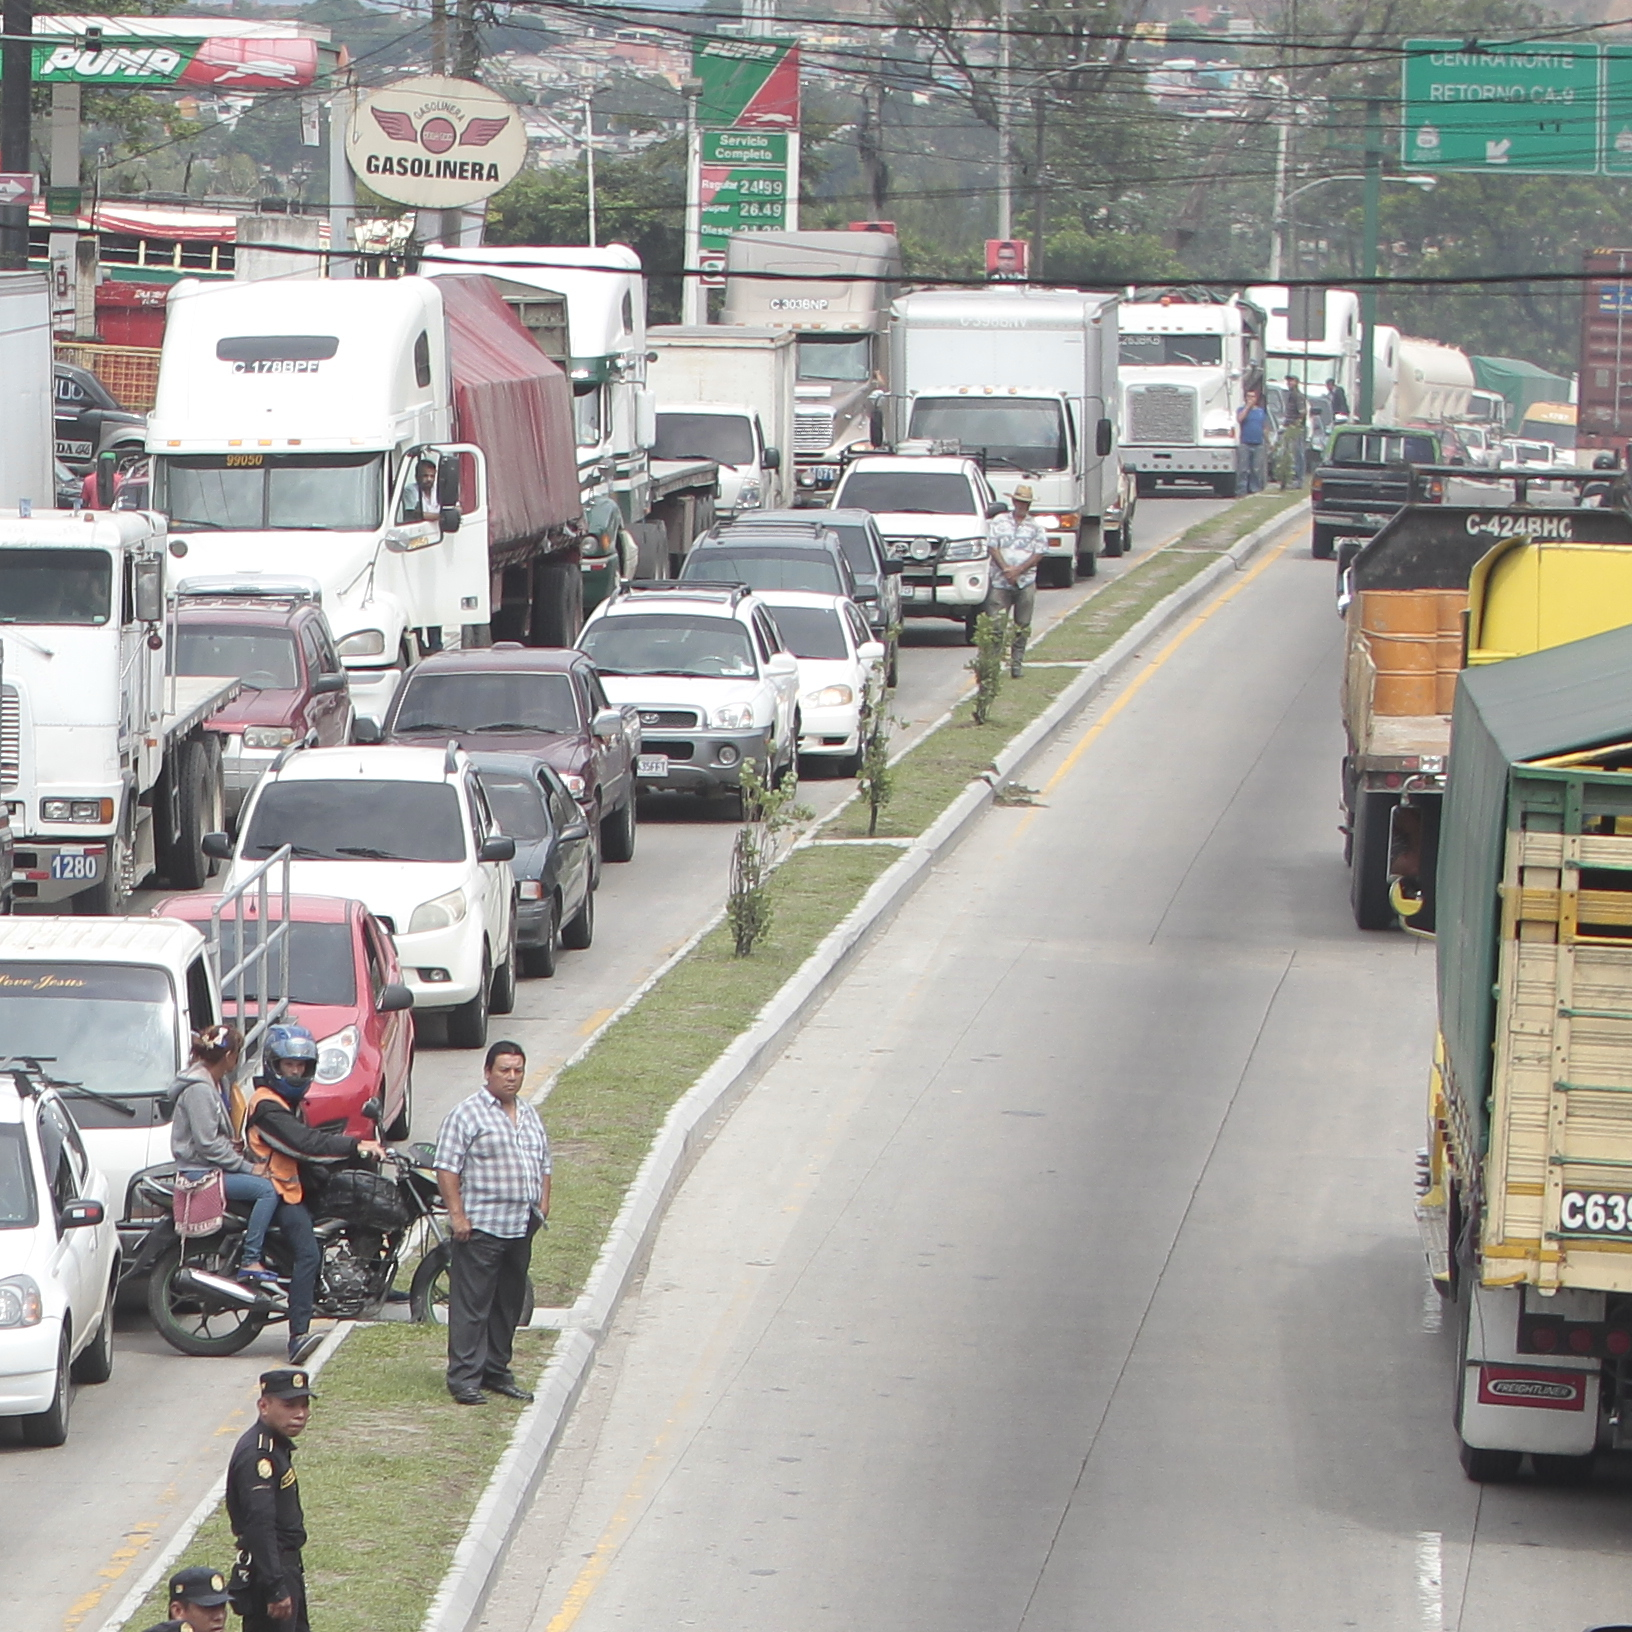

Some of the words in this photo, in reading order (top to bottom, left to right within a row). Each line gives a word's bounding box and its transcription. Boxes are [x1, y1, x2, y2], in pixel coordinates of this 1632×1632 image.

[40, 46, 182, 76] PUMA
[1510, 52, 1575, 70] NORTE
[1430, 84, 1526, 105] RETORNO
[719, 135, 769, 147] Servicio
[715, 147, 773, 162] Completo
[366, 154, 500, 182] GASOLINERA
[702, 179, 738, 192] Regular
[740, 202, 782, 217] 26.49
[226, 454, 263, 466] 99050
[52, 856, 97, 879] 1280
[1496, 1382, 1569, 1396] FREIGHTLINER
